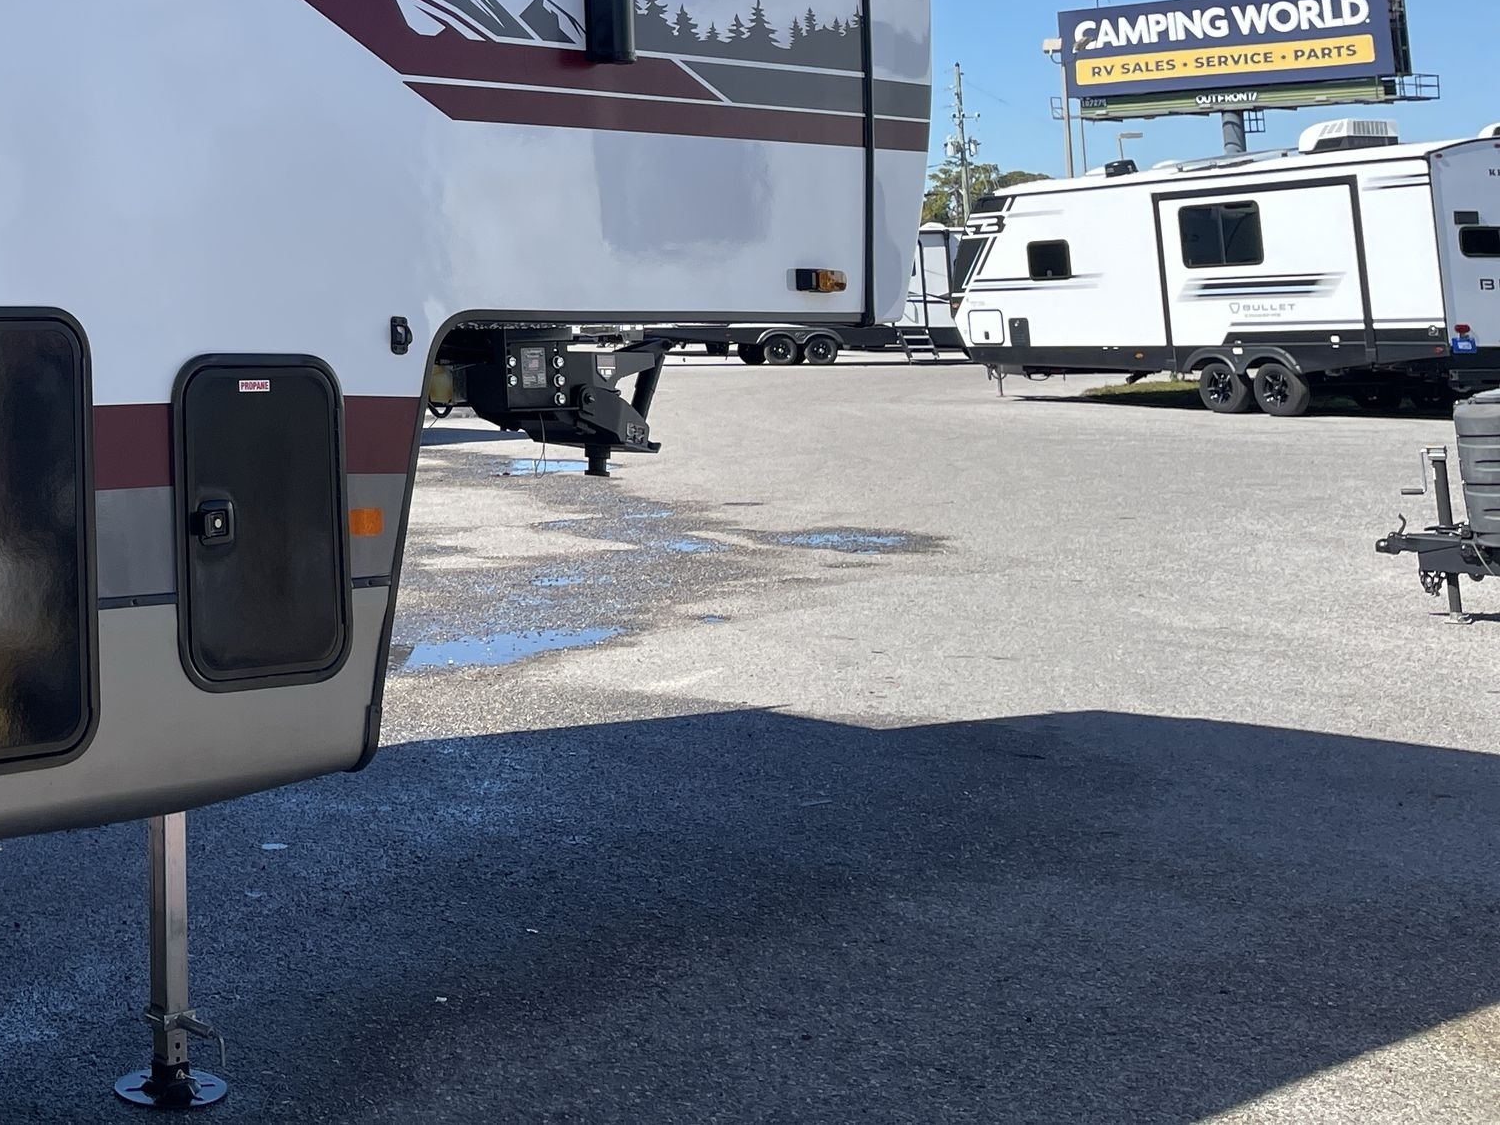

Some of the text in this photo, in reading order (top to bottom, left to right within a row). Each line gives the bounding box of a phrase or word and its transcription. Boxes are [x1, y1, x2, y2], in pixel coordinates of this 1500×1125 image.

[1074, 7, 1229, 50] CAMPING
[1091, 44, 1358, 78] RV SALES SERVICE PARTS
[240, 381, 269, 391] PROPANE
